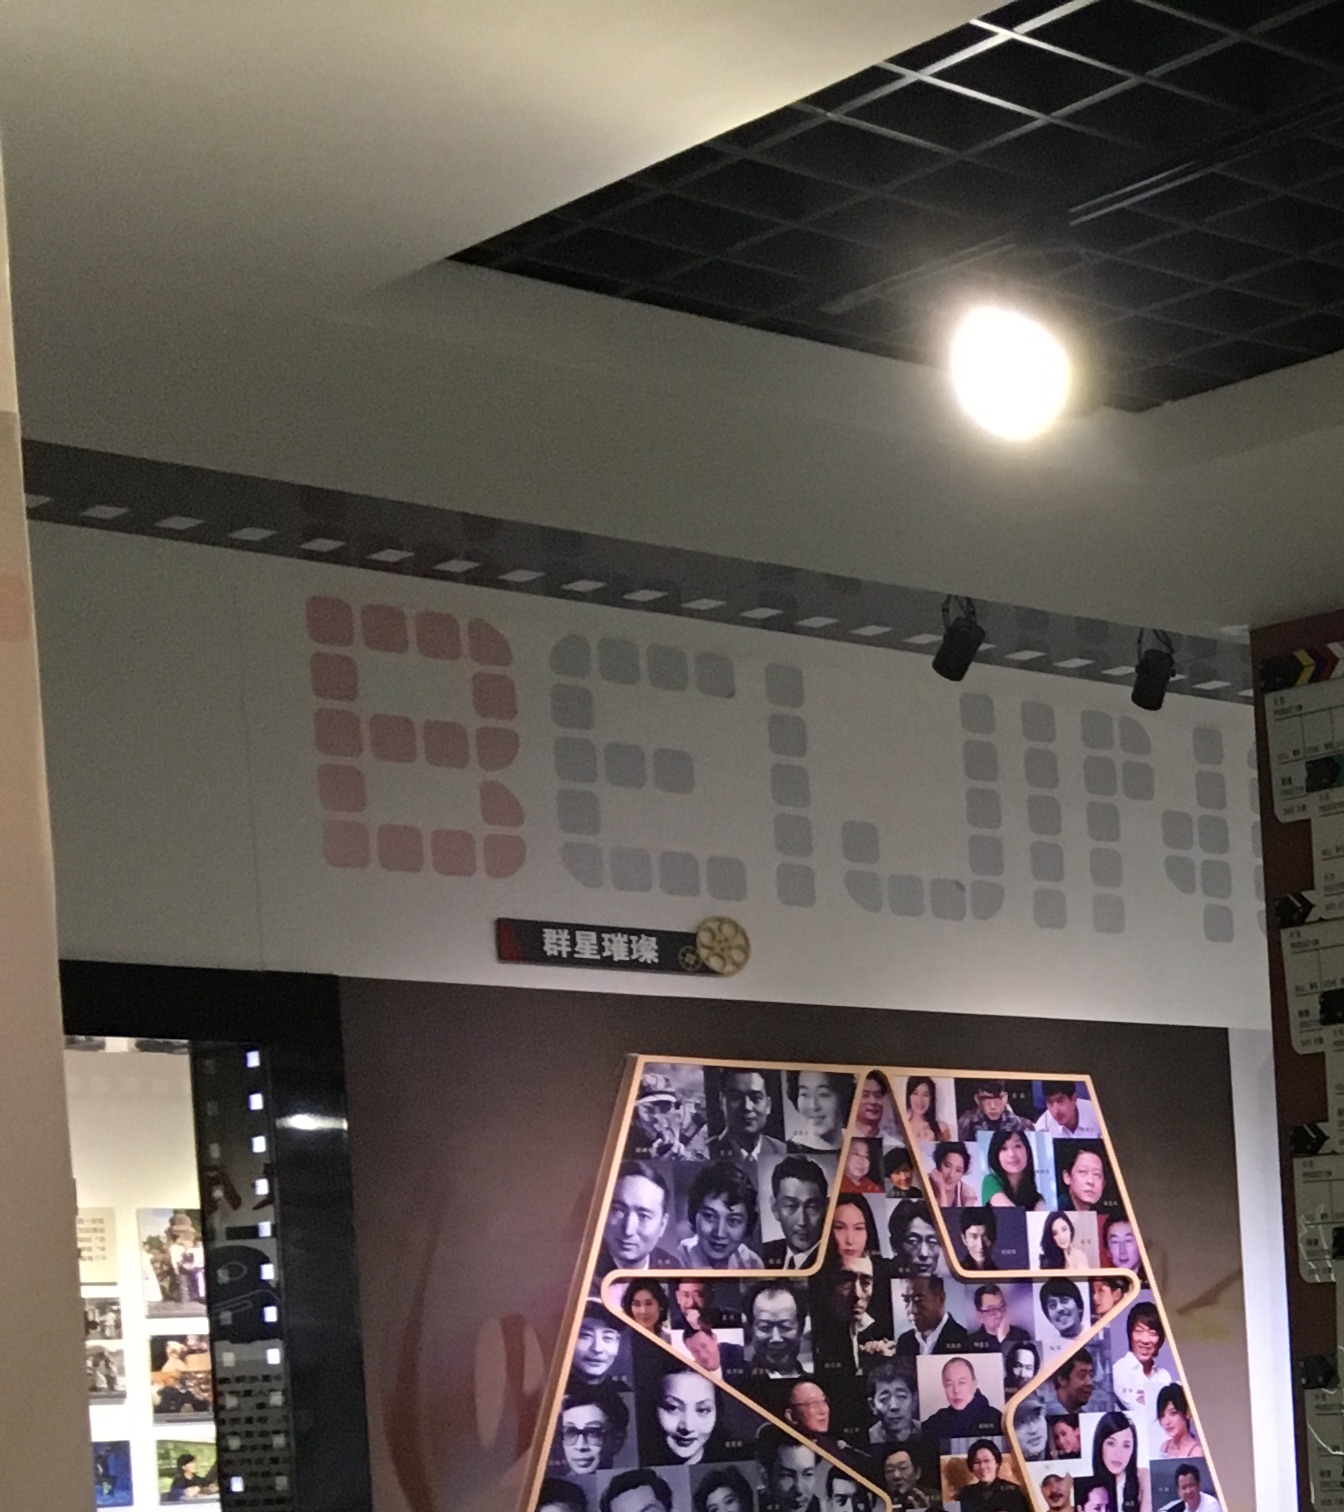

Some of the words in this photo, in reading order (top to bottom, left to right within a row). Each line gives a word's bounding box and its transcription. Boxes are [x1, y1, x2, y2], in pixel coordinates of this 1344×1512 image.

[305, 593, 1267, 944] BEIJIN
[541, 926, 661, 965] 群星璀璨
